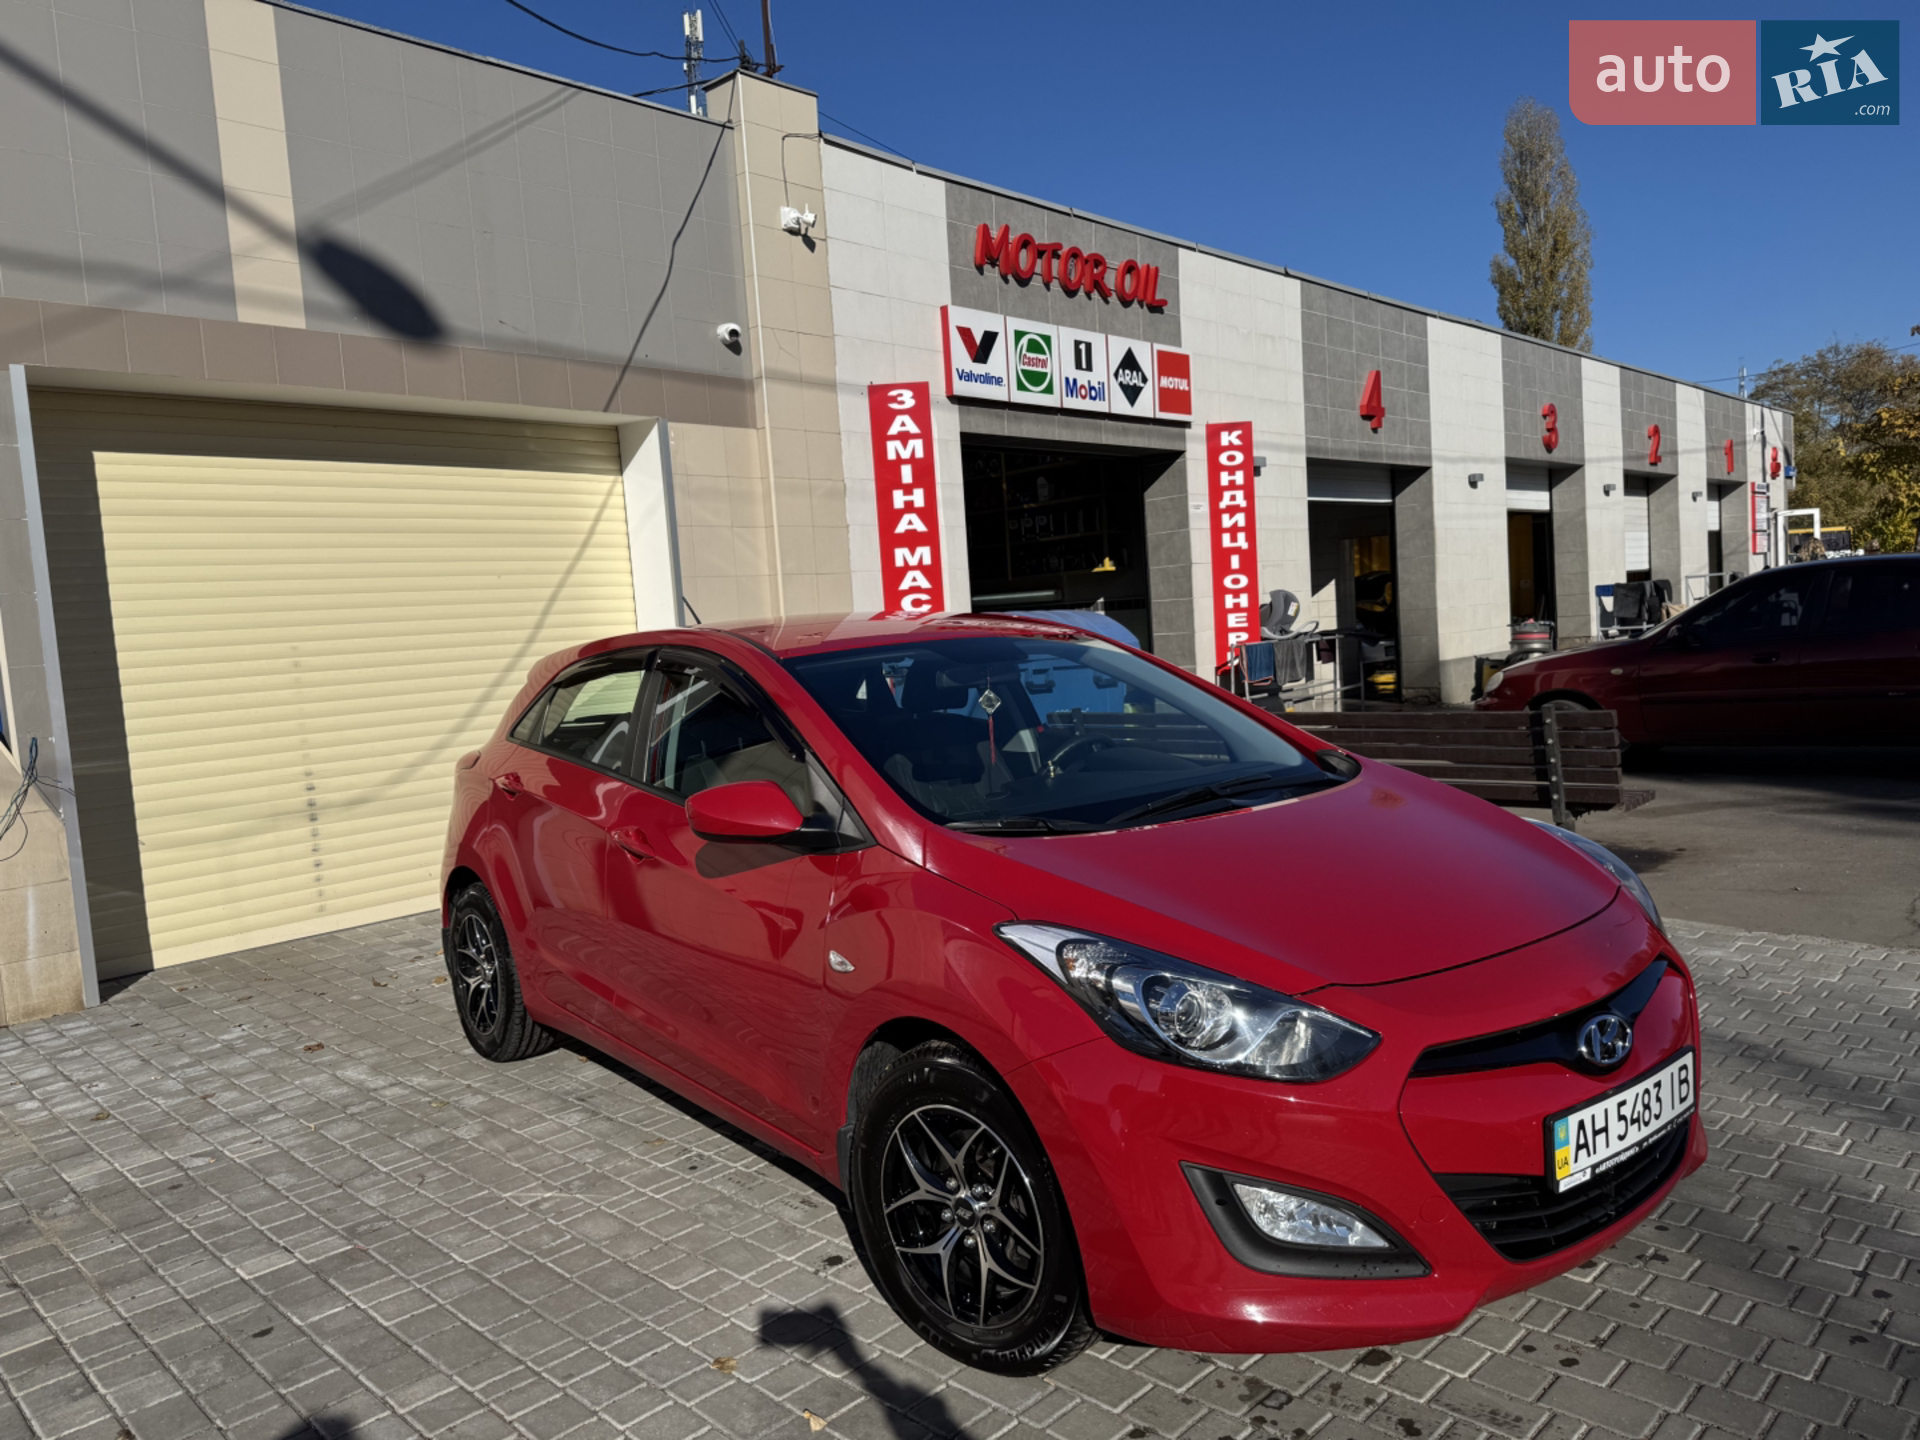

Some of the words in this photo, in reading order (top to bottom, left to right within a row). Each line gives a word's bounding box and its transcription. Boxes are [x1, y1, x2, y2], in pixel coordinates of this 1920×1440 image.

[974, 223, 1112, 299] MOTOR
[1115, 259, 1169, 309] OIL
[955, 367, 1005, 387] Valvoline
[1021, 353, 1049, 370] Castrol
[1117, 368, 1145, 387] ARAL
[1065, 376, 1106, 402] Mobil
[1159, 378, 1189, 391] MOTUL
[1359, 370, 1386, 430] 4
[1541, 403, 1559, 452] 3
[1647, 424, 1662, 464] 2
[886, 388, 928, 534] ЗАМІНА
[1723, 439, 1735, 474] 1
[1574, 1107, 1610, 1164] AH
[1616, 1079, 1663, 1142] 5483
[1669, 1063, 1690, 1111] IB
[1557, 1155, 1569, 1170] UA
